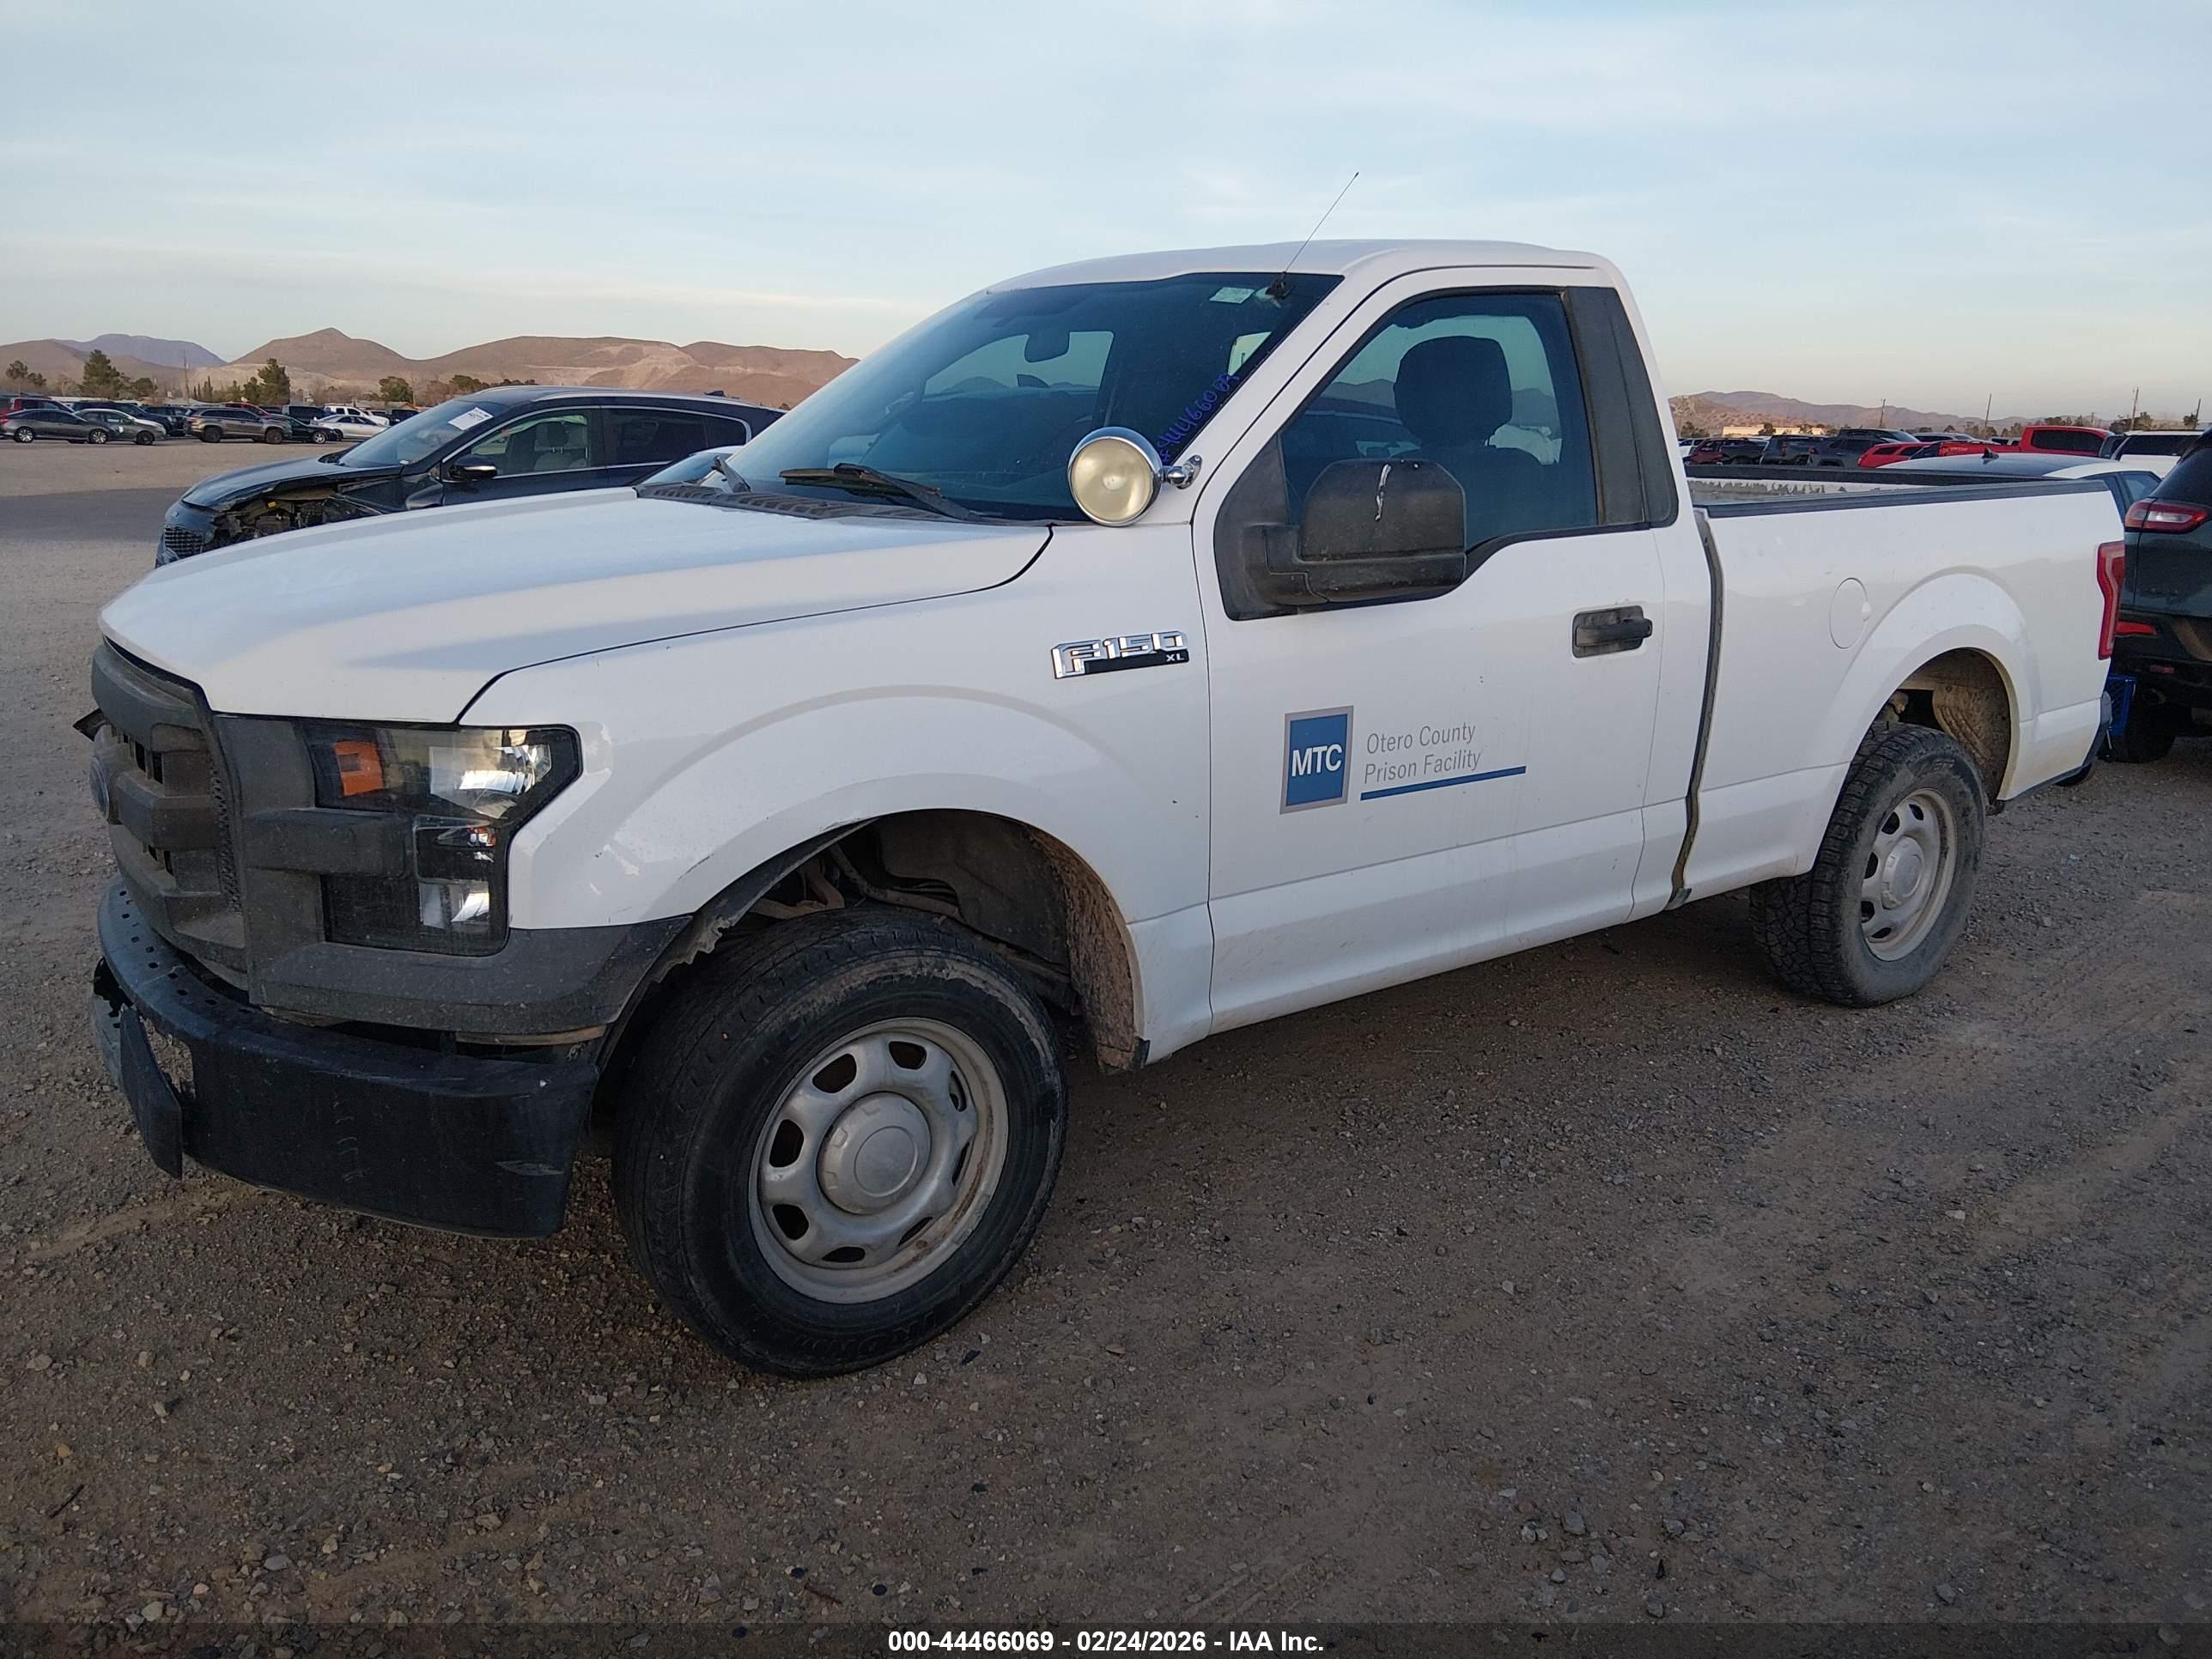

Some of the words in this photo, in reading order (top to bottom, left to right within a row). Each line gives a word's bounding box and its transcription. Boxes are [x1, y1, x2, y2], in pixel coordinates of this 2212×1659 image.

[1165, 653, 1185, 662] XL
[1366, 732, 1413, 754] Otero
[1419, 721, 1476, 747] County
[1291, 743, 1342, 777] MTC
[1364, 763, 1417, 785] Prison
[1423, 749, 1481, 776] Facility
